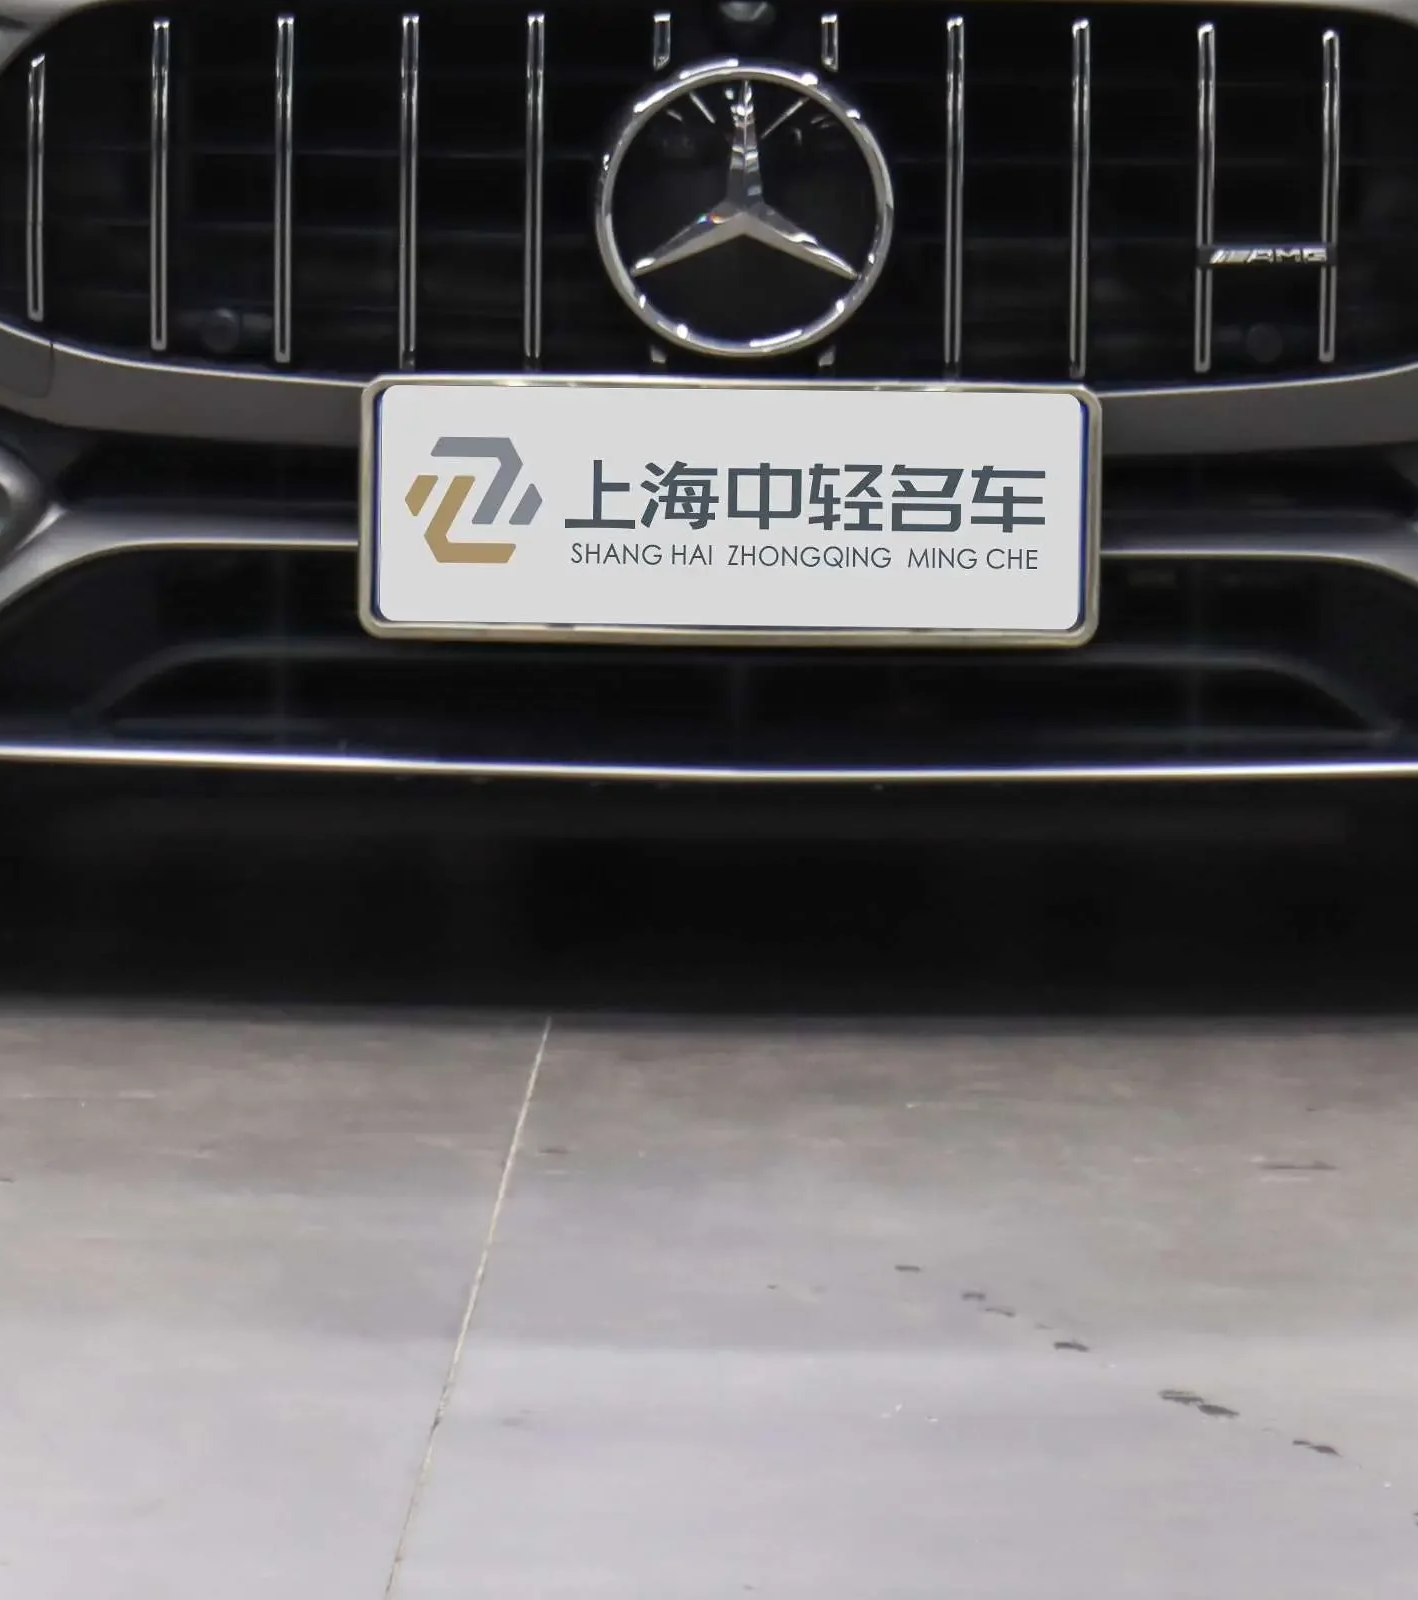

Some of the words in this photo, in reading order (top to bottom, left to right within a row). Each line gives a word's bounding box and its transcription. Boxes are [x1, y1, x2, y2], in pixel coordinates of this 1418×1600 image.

[564, 459, 1046, 534] 上海中轻名车
[570, 542, 663, 566] SHANG
[671, 543, 713, 566] HAI
[727, 544, 892, 569] ZHONGQING
[907, 547, 978, 570] MING
[986, 547, 1038, 570] CHE
